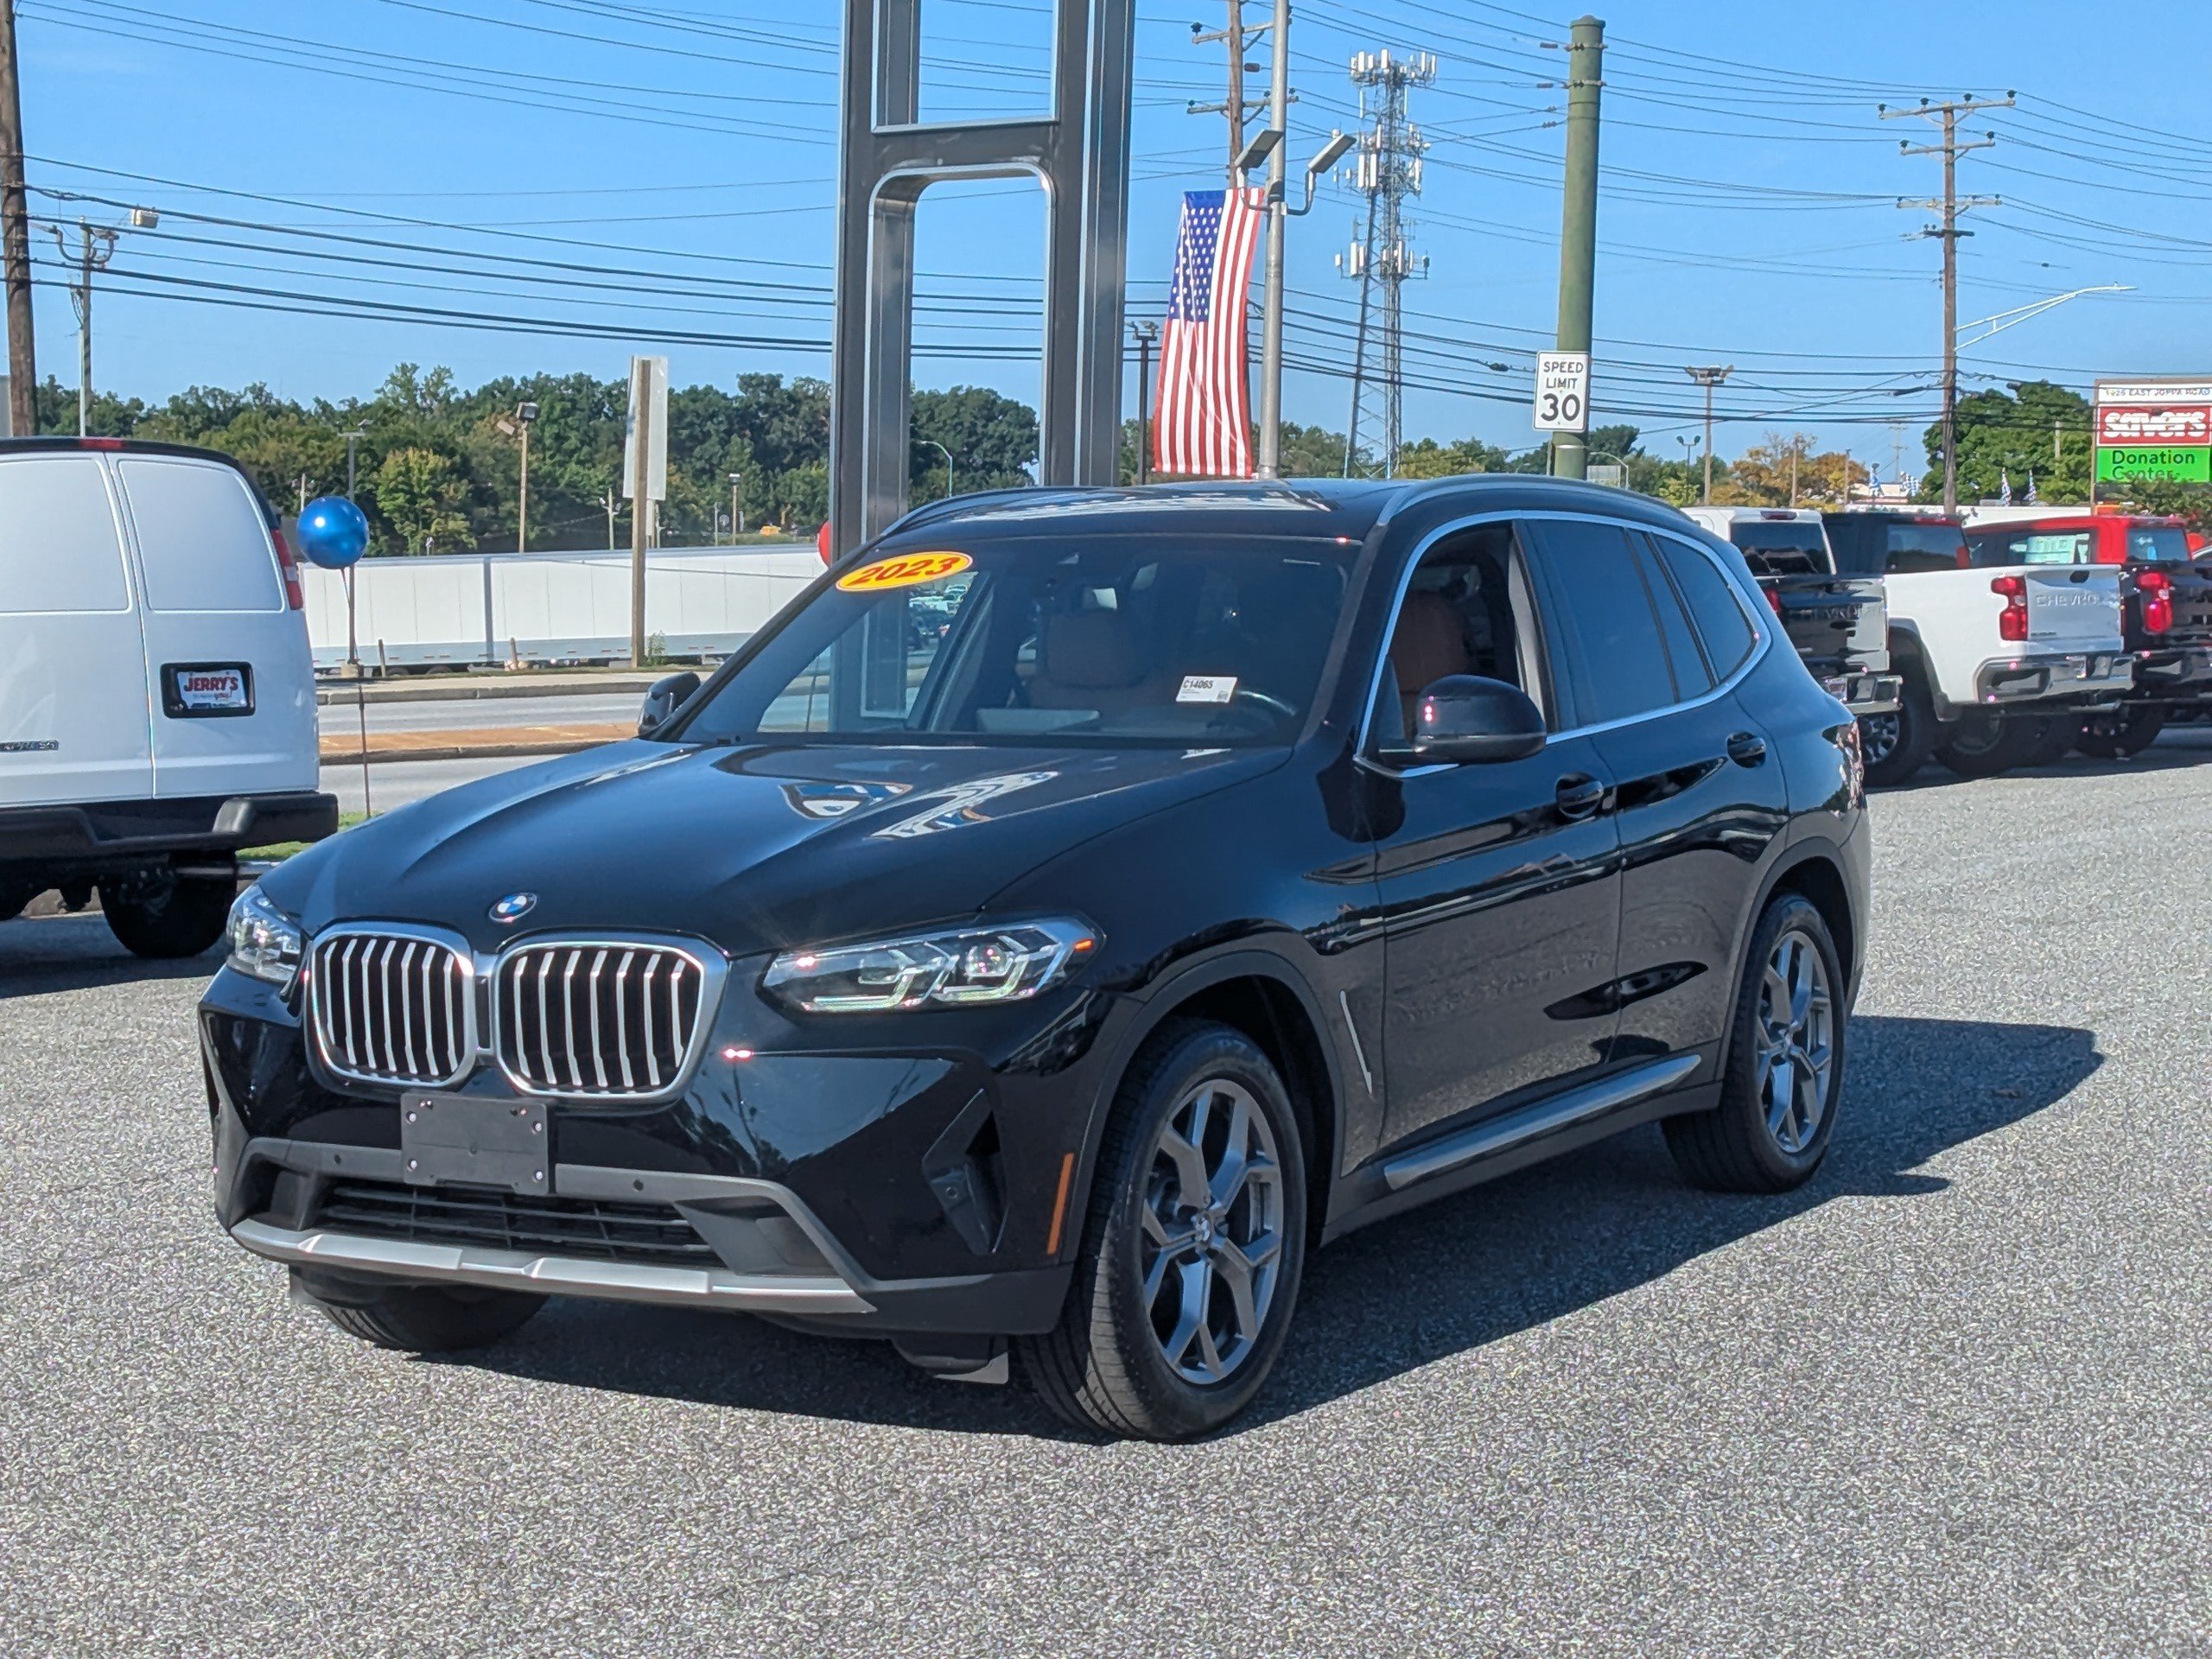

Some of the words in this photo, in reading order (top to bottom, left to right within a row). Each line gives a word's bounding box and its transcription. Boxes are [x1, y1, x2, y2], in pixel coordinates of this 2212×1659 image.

[1543, 361, 1584, 373] SPEED
[1546, 378, 1578, 389] LIMIT
[2128, 388, 2151, 397] EAST
[1541, 393, 1580, 422] 30
[2112, 449, 2196, 465] Donation
[846, 556, 961, 587] 2023
[184, 677, 238, 692] JERRY'S
